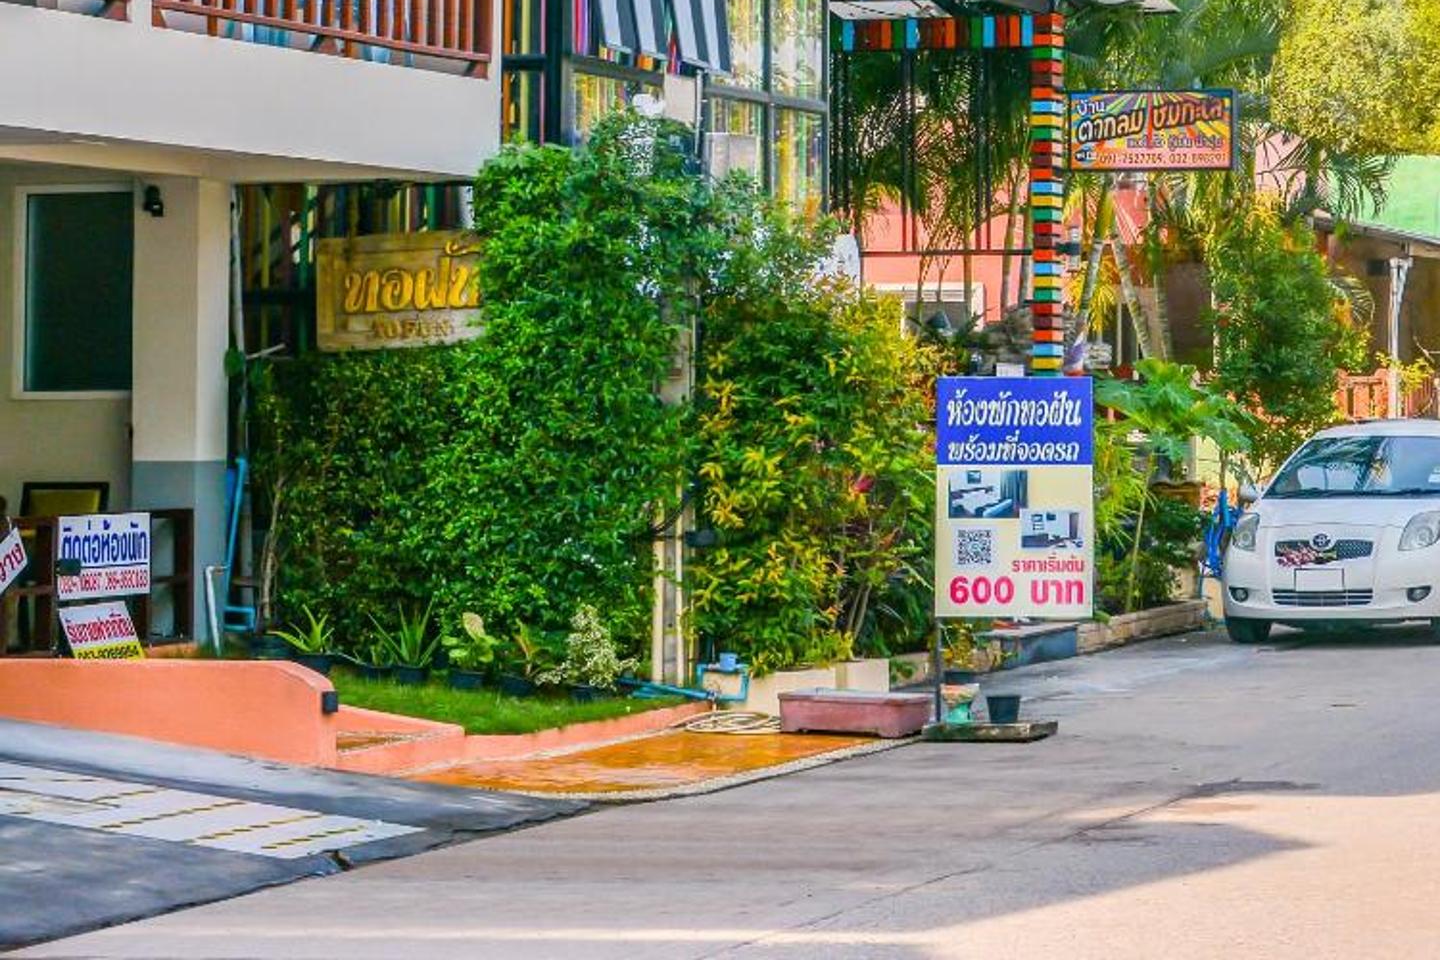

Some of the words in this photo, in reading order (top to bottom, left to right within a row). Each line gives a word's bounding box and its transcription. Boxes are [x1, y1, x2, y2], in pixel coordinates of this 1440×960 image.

[1077, 98, 1105, 116] บ้าน
[1077, 108, 1146, 143] ตากลม
[1152, 97, 1223, 129] ชมทะเล
[946, 388, 1082, 427] ห้องพักทอฝัน
[947, 430, 1080, 463] พร้อมที่จอดรถ
[62, 520, 148, 564] ติดต่อห้องพัก
[1011, 552, 1085, 573] ราคาเริ่มต้น
[949, 575, 1015, 605] 600
[1030, 576, 1085, 605] บาท
